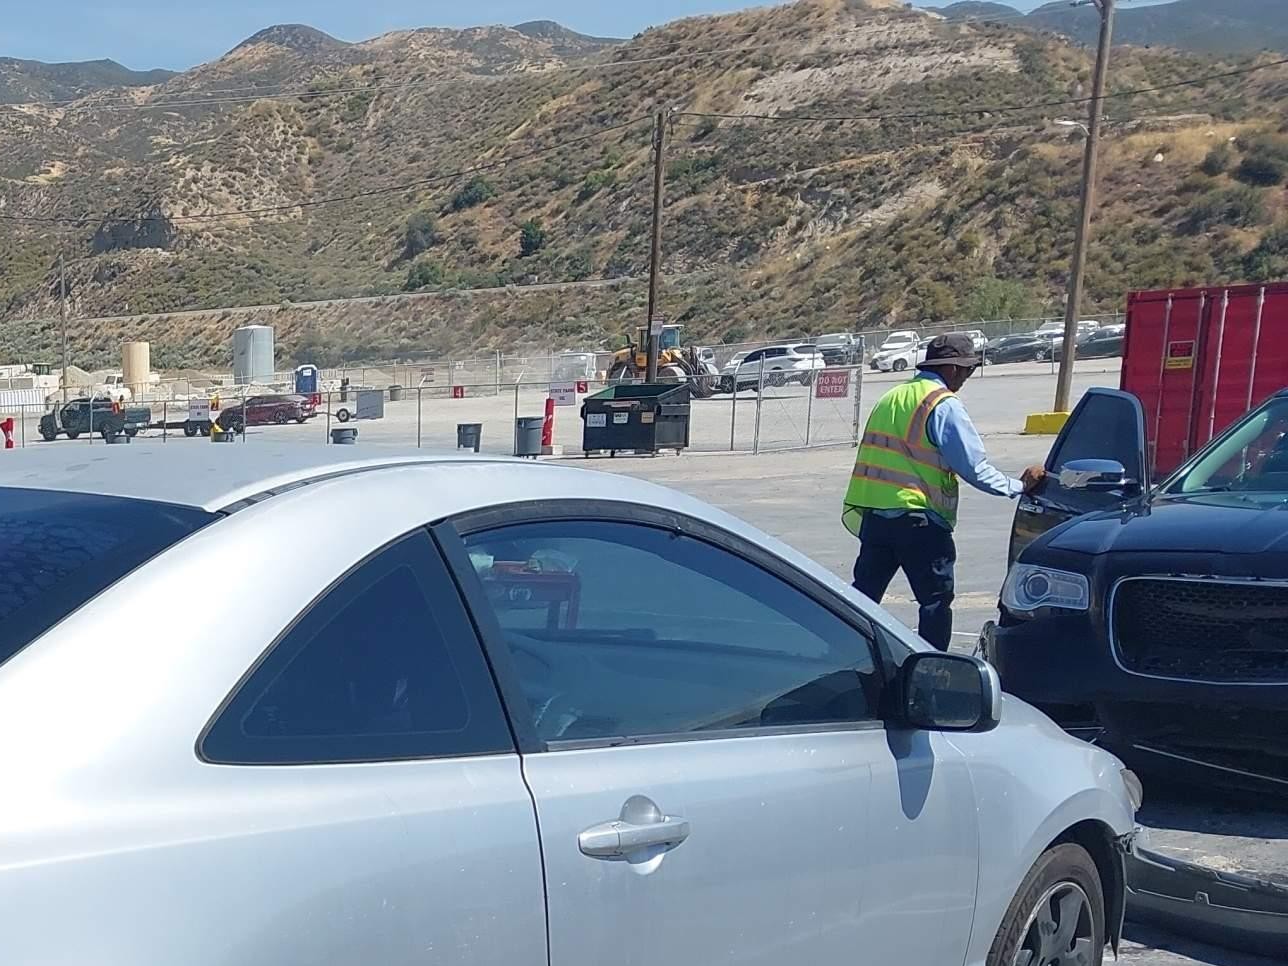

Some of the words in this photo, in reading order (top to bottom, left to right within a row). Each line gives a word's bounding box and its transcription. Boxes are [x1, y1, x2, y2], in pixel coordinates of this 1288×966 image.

[819, 376, 830, 384] DO
[832, 376, 847, 384] NOT
[820, 385, 845, 394] ENTER
